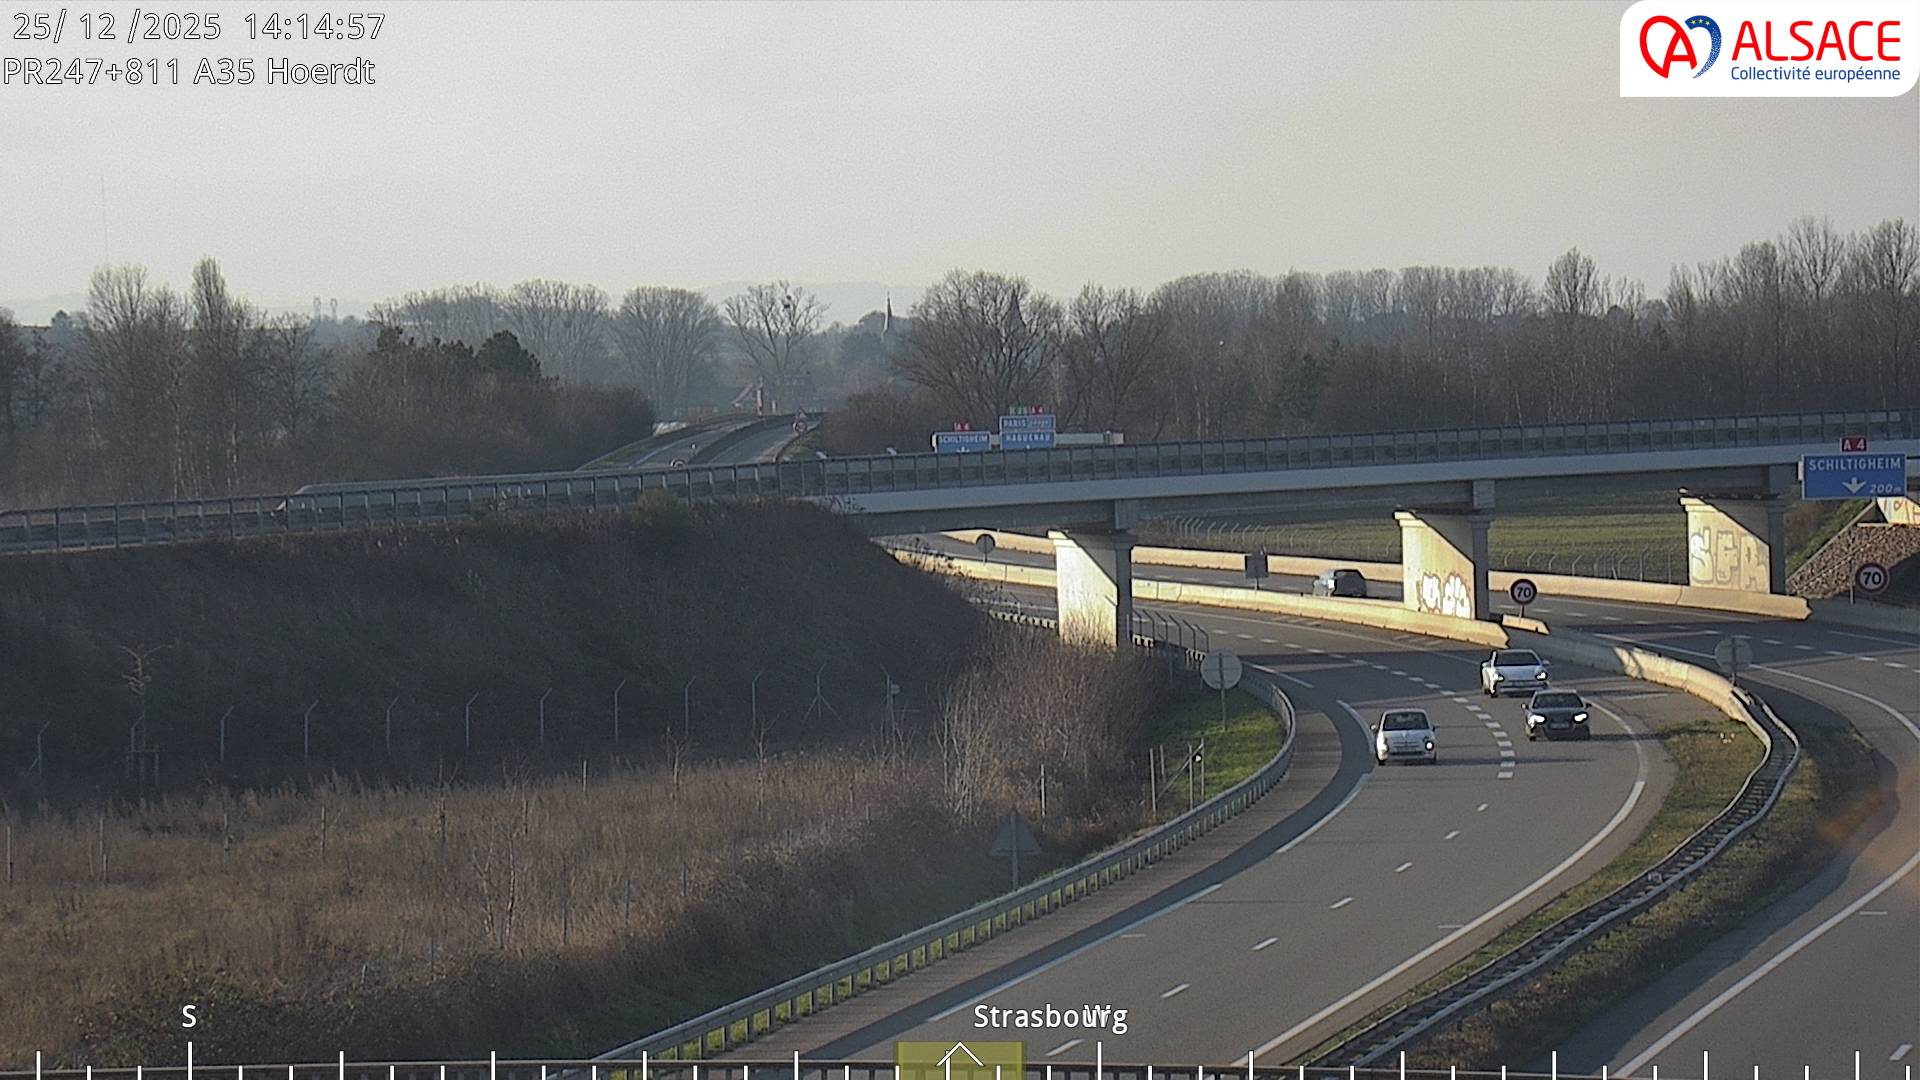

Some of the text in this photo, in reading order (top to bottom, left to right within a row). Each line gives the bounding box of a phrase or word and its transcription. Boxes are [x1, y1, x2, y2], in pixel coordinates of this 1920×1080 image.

[1003, 419, 1026, 428] PARIS
[938, 435, 988, 444] SCHILTIGHEIM
[1006, 433, 1050, 442] HAGUENAU
[1843, 439, 1865, 450] A 4
[1808, 457, 1901, 471] SCHILTIGHEIM
[1863, 571, 1882, 585] 70
[1516, 587, 1532, 598] 70
